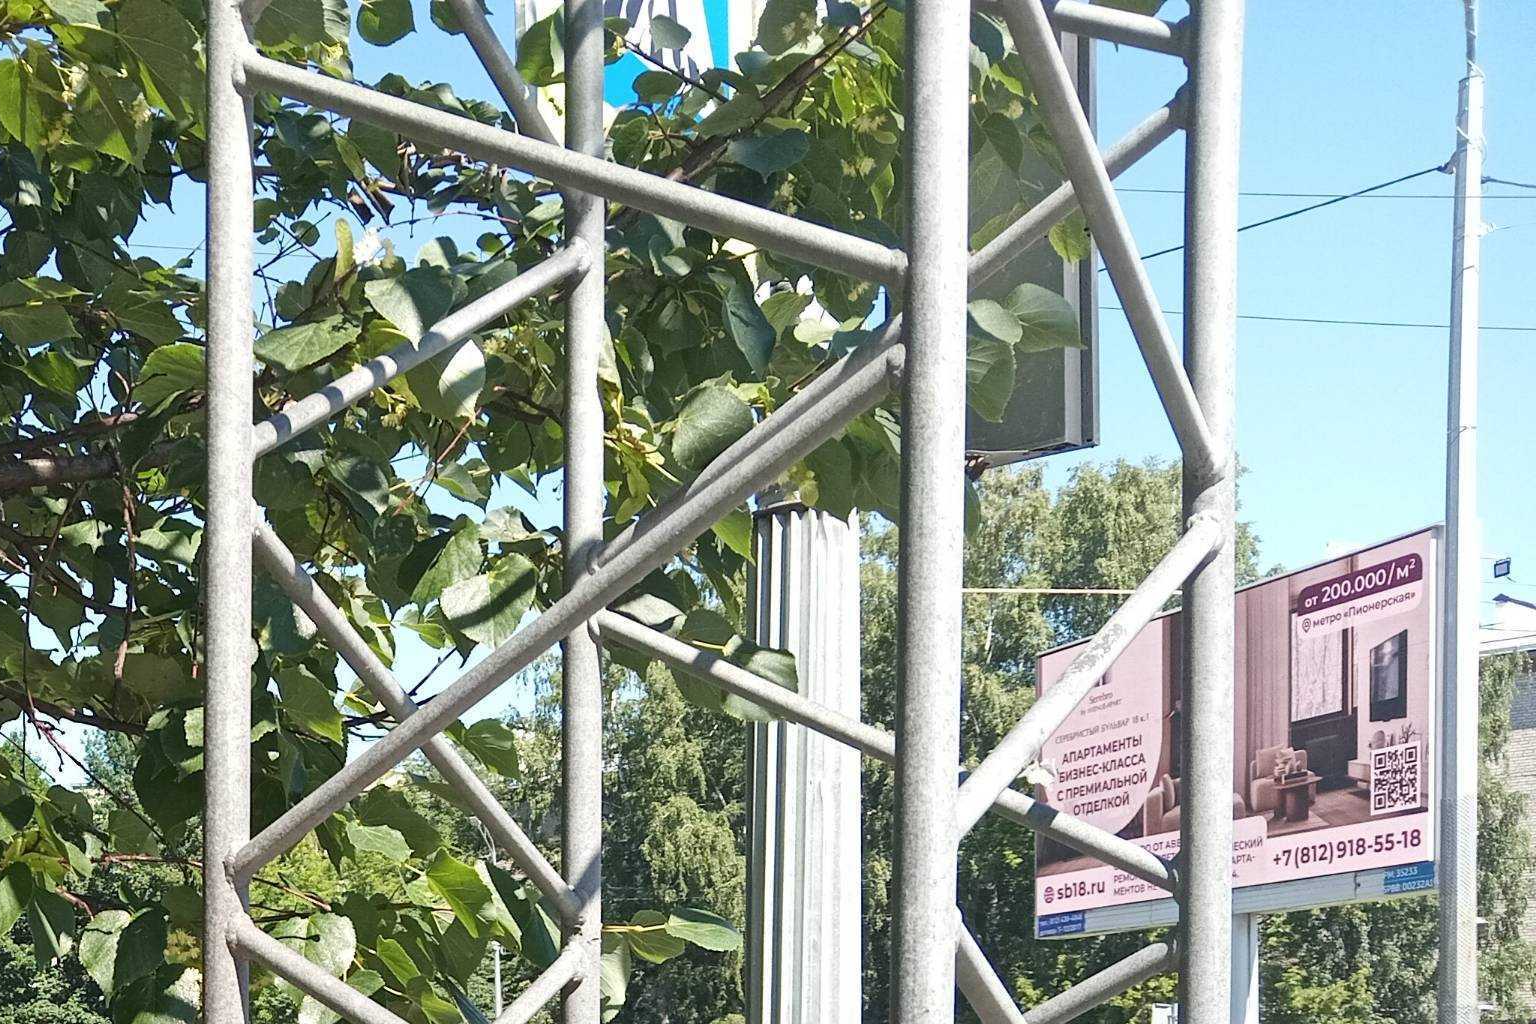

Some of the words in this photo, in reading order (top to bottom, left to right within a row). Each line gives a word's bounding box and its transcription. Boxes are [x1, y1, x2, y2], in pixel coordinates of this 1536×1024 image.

[1304, 595, 1319, 608] от
[1312, 612, 1342, 628] метро
[1062, 734, 1143, 765] АПАРТАМЕНТЫ
[1059, 753, 1146, 783] БИЗНЕС-КЛАССА
[1057, 789, 1065, 801] С
[1065, 769, 1148, 800] ПРЕМИАЛЬНОЙ
[1073, 791, 1130, 816] ОТДЕЛКОЙ
[1057, 880, 1106, 900] sb18.ru
